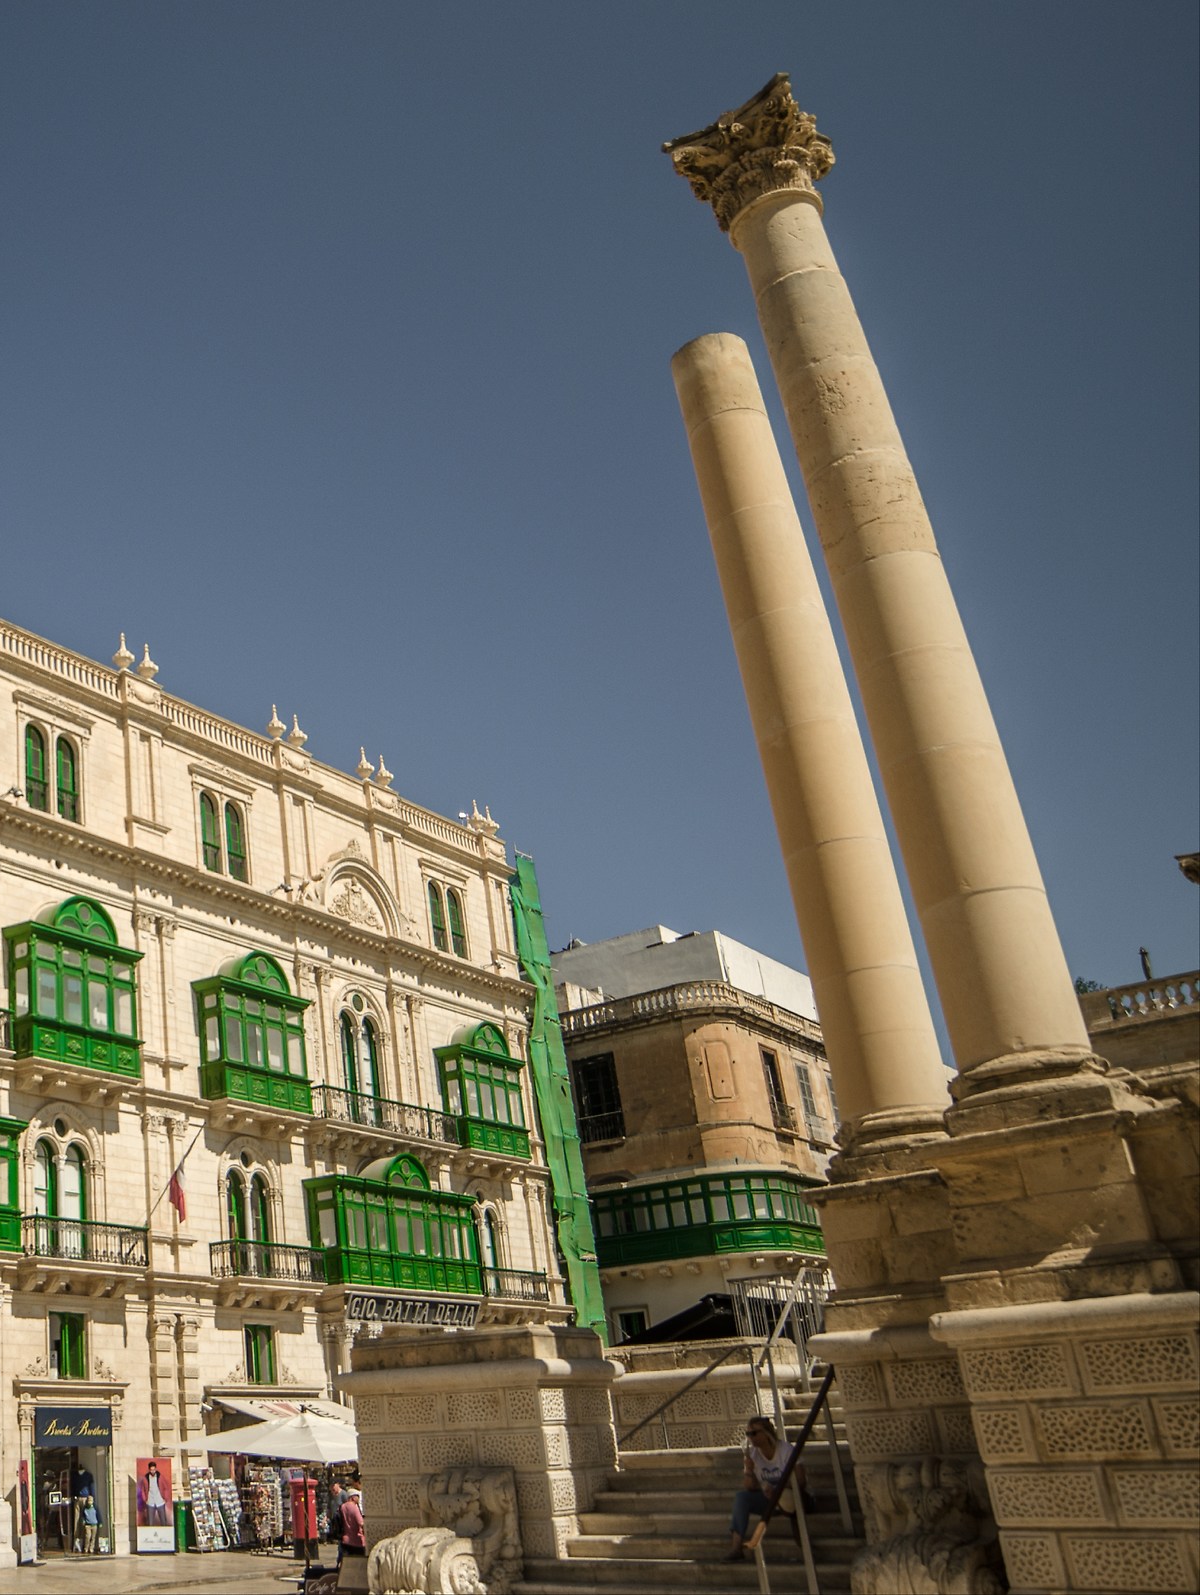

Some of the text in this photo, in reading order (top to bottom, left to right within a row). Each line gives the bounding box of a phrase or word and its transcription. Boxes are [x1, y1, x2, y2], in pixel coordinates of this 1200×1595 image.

[381, 1299, 430, 1323] BATTA
[432, 1303, 476, 1327] DELIA
[76, 1418, 109, 1436] Brothers
